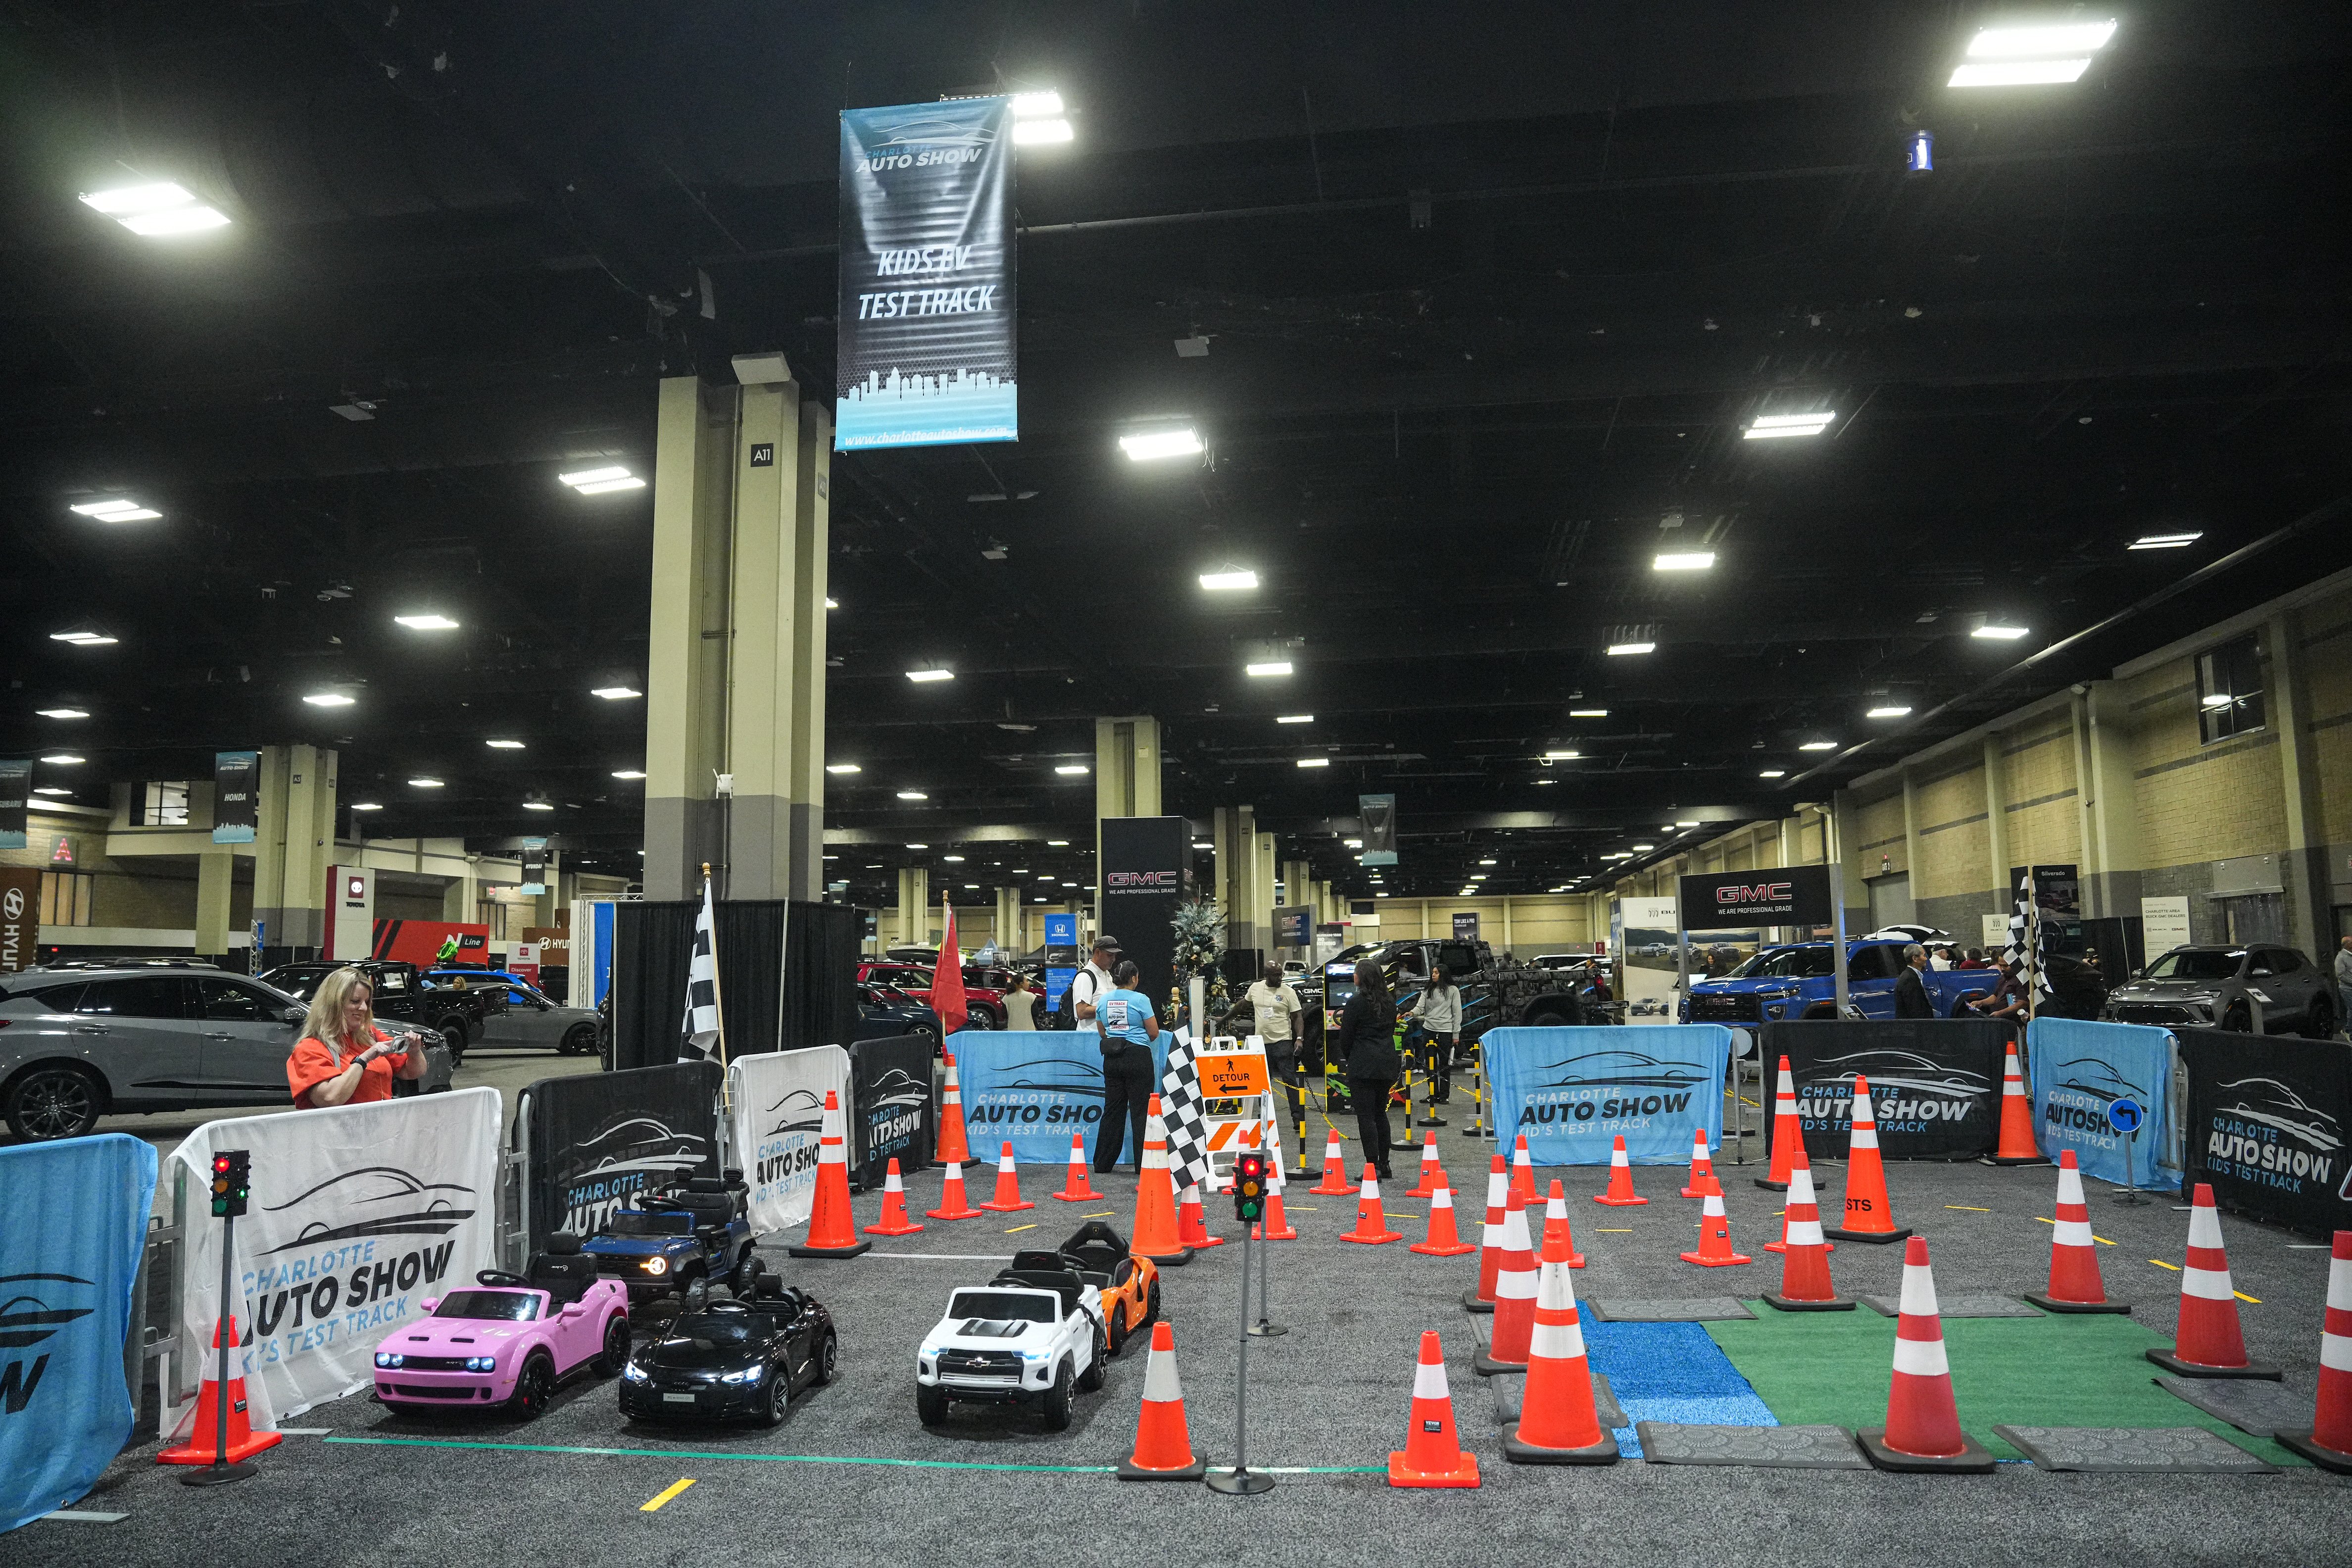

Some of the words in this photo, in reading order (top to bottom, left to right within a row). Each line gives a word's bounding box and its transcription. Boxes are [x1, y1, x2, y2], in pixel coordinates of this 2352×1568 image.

[855, 154, 913, 173] AUTO
[916, 148, 982, 166] SHOW
[865, 145, 932, 158] CHARLOTTE
[877, 249, 934, 276] KIDS
[937, 245, 972, 272] EV
[859, 291, 915, 320] TEST
[918, 285, 997, 315] TRACK
[754, 448, 770, 461] A11
[224, 793, 246, 801] HONDA
[1108, 872, 1176, 885] GMC
[1716, 882, 1792, 903] GMC
[1213, 1073, 1250, 1082] DETOUR
[978, 1094, 1066, 1104] CHARLOTTE
[1526, 1087, 1621, 1105] CHARLOTTE
[1802, 1087, 1899, 1098] CHARLTTE
[2049, 1091, 2100, 1111] CHARLOTTE
[969, 1105, 1040, 1123] AUTO
[1045, 1105, 1102, 1123] SHO
[1519, 1102, 1595, 1126] AUTO
[1601, 1092, 1692, 1119] SHOW
[1797, 1098, 1854, 1118] AUT
[1877, 1099, 1971, 1121] SHOW
[2046, 1103, 2086, 1129] AUTO
[893, 1110, 921, 1137] SHOW
[966, 1126, 1000, 1134] KID'S
[1007, 1126, 1039, 1134] TEST
[1045, 1125, 1091, 1134] TRACK
[1559, 1122, 1596, 1134] TEST
[1601, 1118, 1652, 1130] TRACK
[1800, 1120, 1827, 1130] ID'S
[1833, 1121, 1852, 1130] TE
[1878, 1121, 1927, 1132] TRACK
[2213, 1117, 2277, 1143] CHARLOTTE
[758, 1133, 804, 1158] CHARLOTTE
[893, 1135, 909, 1150] TRACK
[2046, 1125, 2061, 1137] ID'S
[2084, 1133, 2116, 1151] TRACK
[757, 1152, 792, 1187] AUTO
[795, 1143, 820, 1172] SHO
[2209, 1131, 2259, 1164] AUTO
[2261, 1144, 2332, 1183] SHOW
[569, 1173, 643, 1206] CHARLOTTE
[776, 1178, 792, 1195] TEST
[795, 1169, 816, 1187] TRACK
[2235, 1164, 2259, 1182] TEST
[2261, 1172, 2301, 1193] TRACK
[1847, 1199, 1872, 1211] STS
[242, 1240, 375, 1296] CHARLOTTE
[346, 1239, 455, 1308] SHOW
[288, 1318, 339, 1355] TEST
[347, 1295, 408, 1336] TRACK
